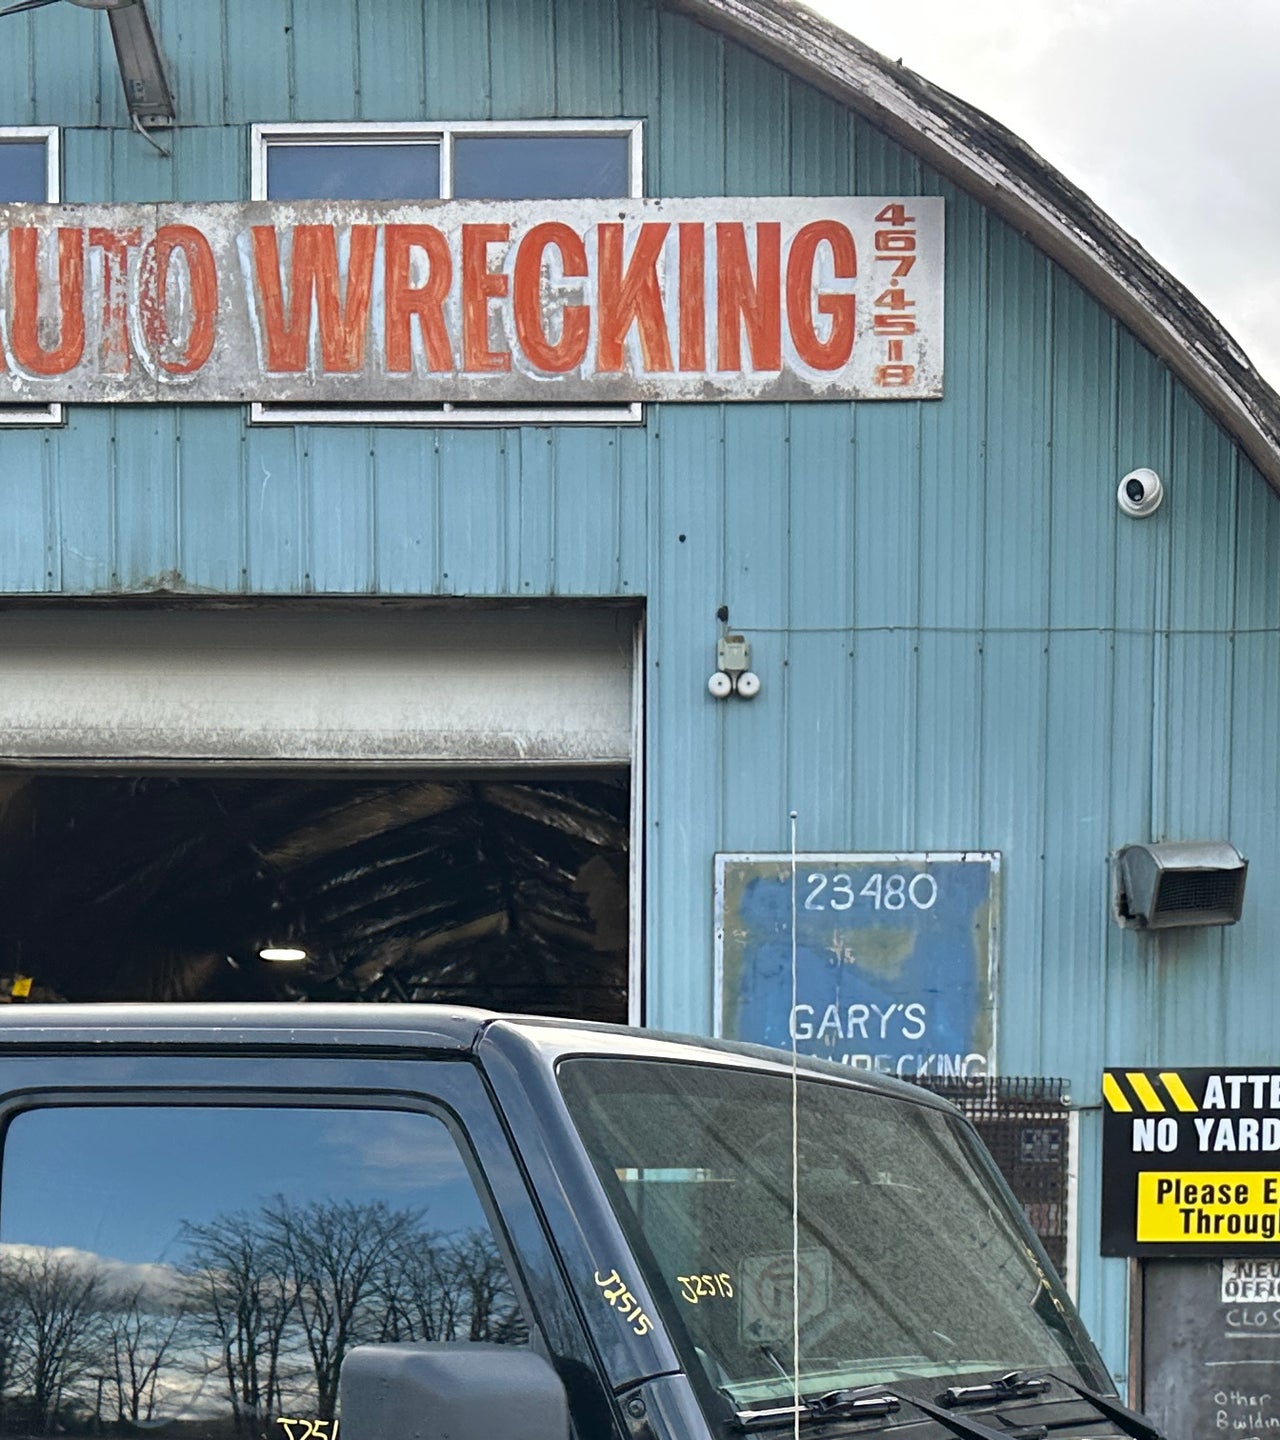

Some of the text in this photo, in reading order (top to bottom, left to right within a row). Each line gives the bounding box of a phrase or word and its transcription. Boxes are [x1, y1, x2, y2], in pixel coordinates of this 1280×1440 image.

[250, 219, 858, 374] WRECKING
[804, 872, 939, 911] 23480
[789, 1002, 927, 1041] GARY'S
[1132, 1118, 1178, 1153] NO
[1156, 1177, 1249, 1206] Please
[593, 1268, 655, 1337] J2515
[676, 1272, 734, 1304] J2515
[1214, 1391, 1272, 1407] Other
